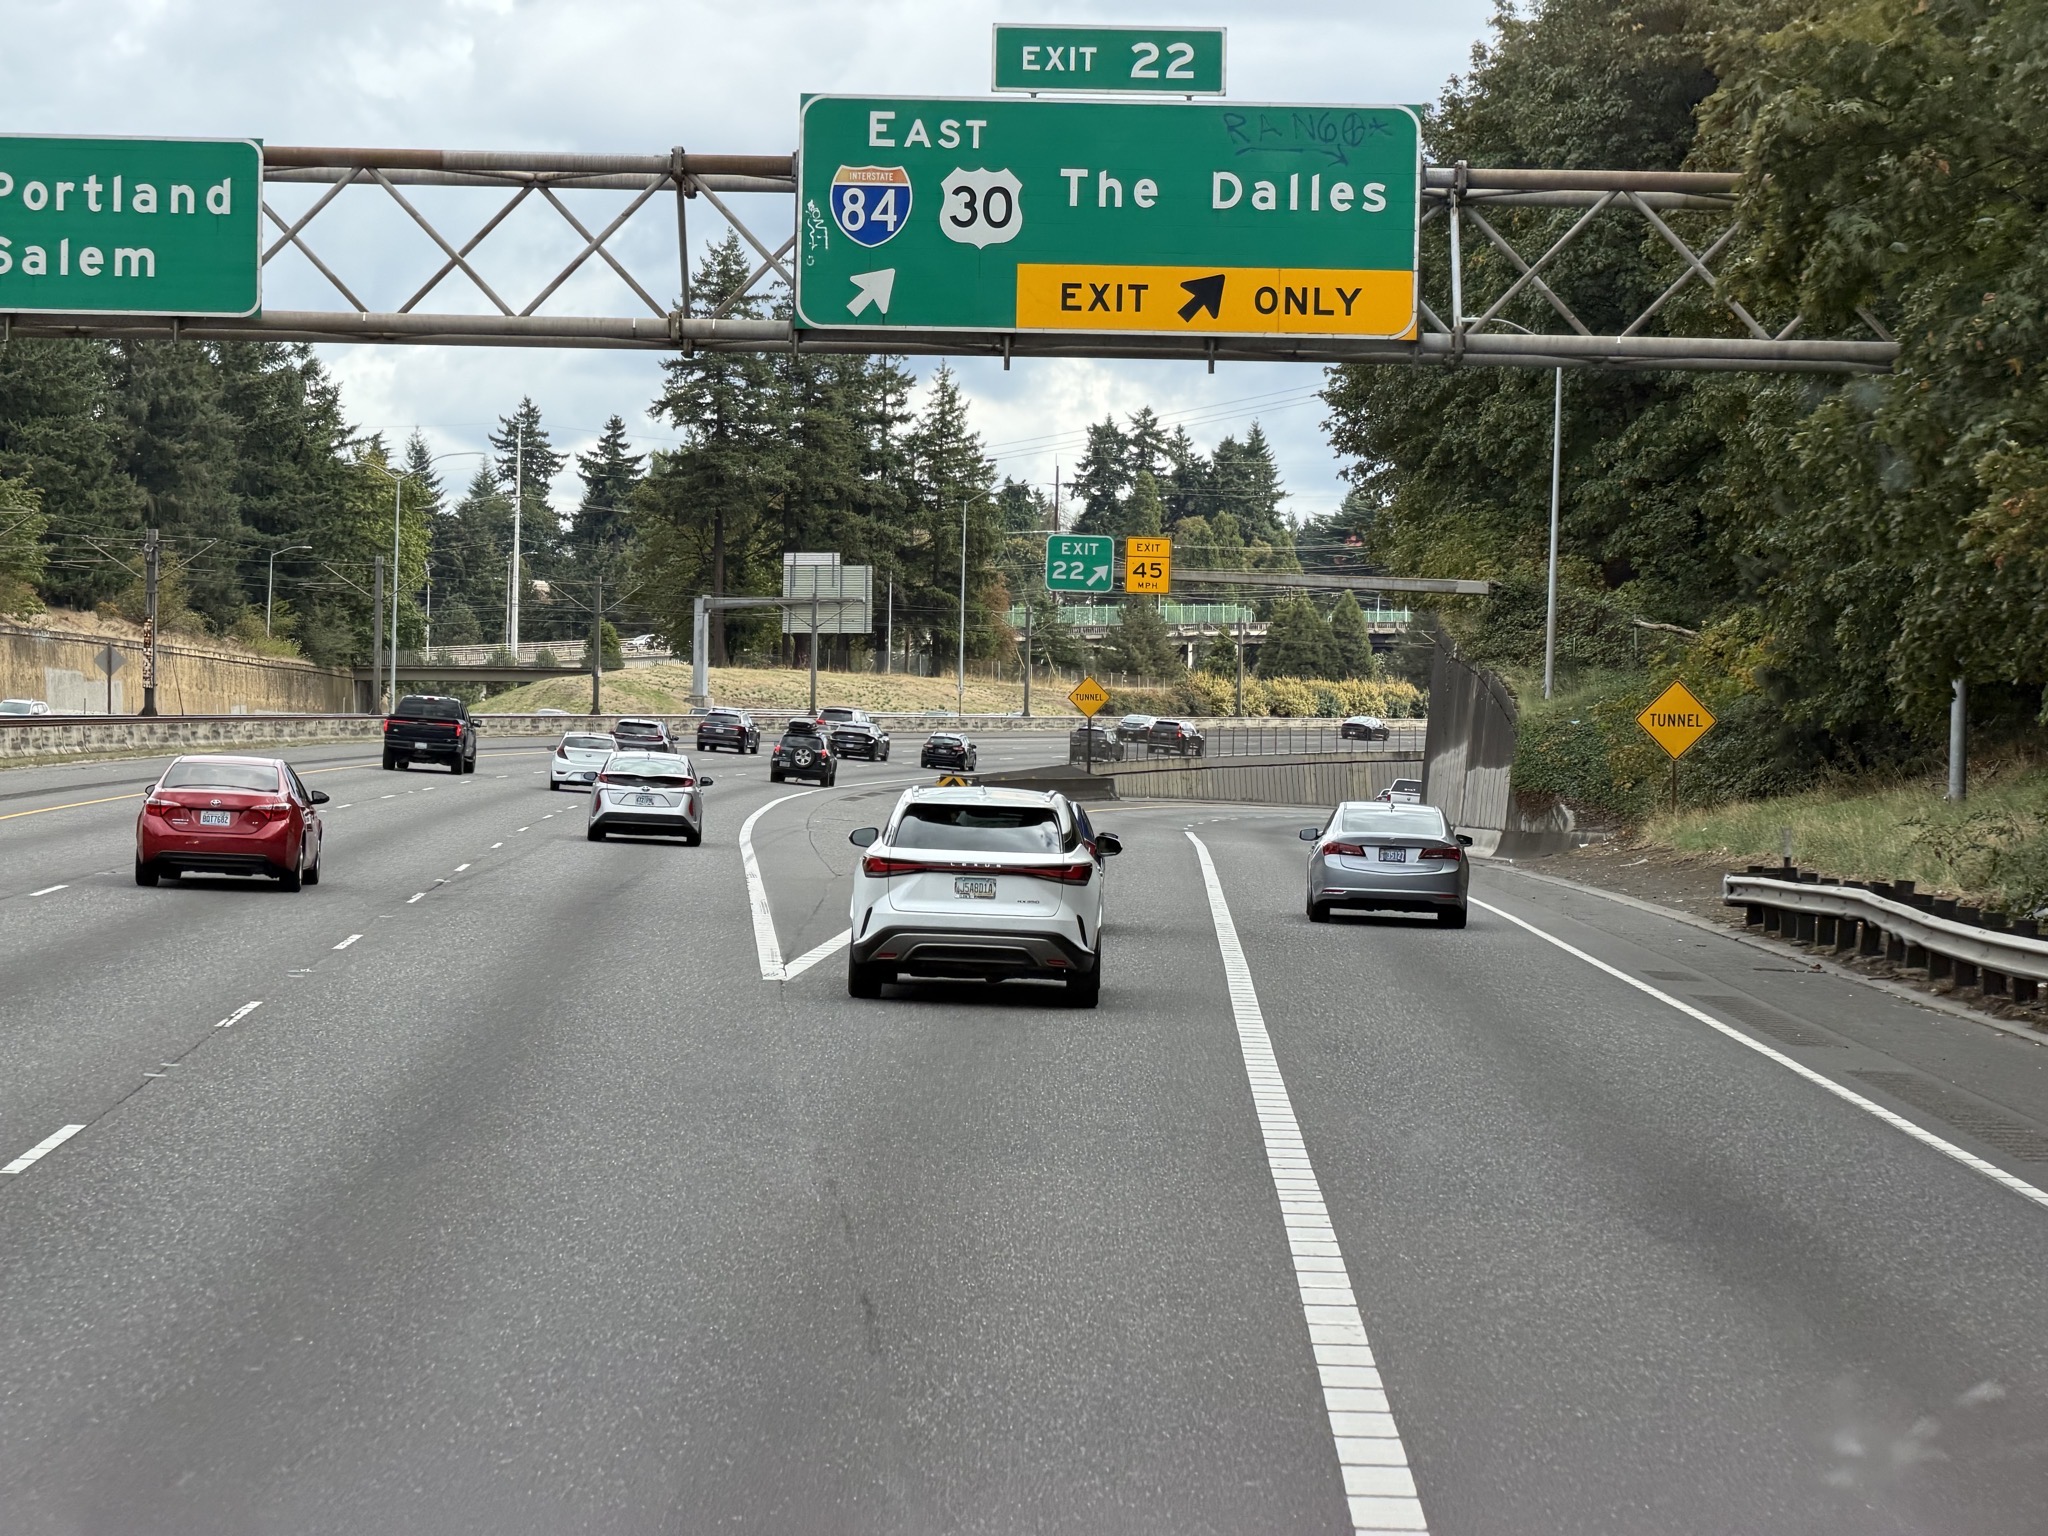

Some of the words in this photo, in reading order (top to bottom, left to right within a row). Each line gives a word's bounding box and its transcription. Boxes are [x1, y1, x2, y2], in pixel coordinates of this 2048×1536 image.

[1022, 45, 1098, 72] EXIT
[1130, 41, 1195, 79] 22
[868, 110, 987, 149] EAST
[849, 171, 894, 181] INTERSTATE
[1060, 168, 1159, 208] The
[1212, 171, 1387, 213] Dalles
[841, 187, 898, 232] 84
[949, 185, 1014, 229] 30
[1060, 282, 1149, 313] EXIT
[1254, 286, 1363, 317] ONLY
[1061, 542, 1099, 556] EXIT
[1136, 543, 1161, 553] EXIT
[1052, 560, 1084, 580] 22
[1132, 562, 1163, 579] 45
[1137, 582, 1158, 590] MPH
[1075, 693, 1104, 702] TUNNEL
[1649, 712, 1704, 729] TUNNEL
